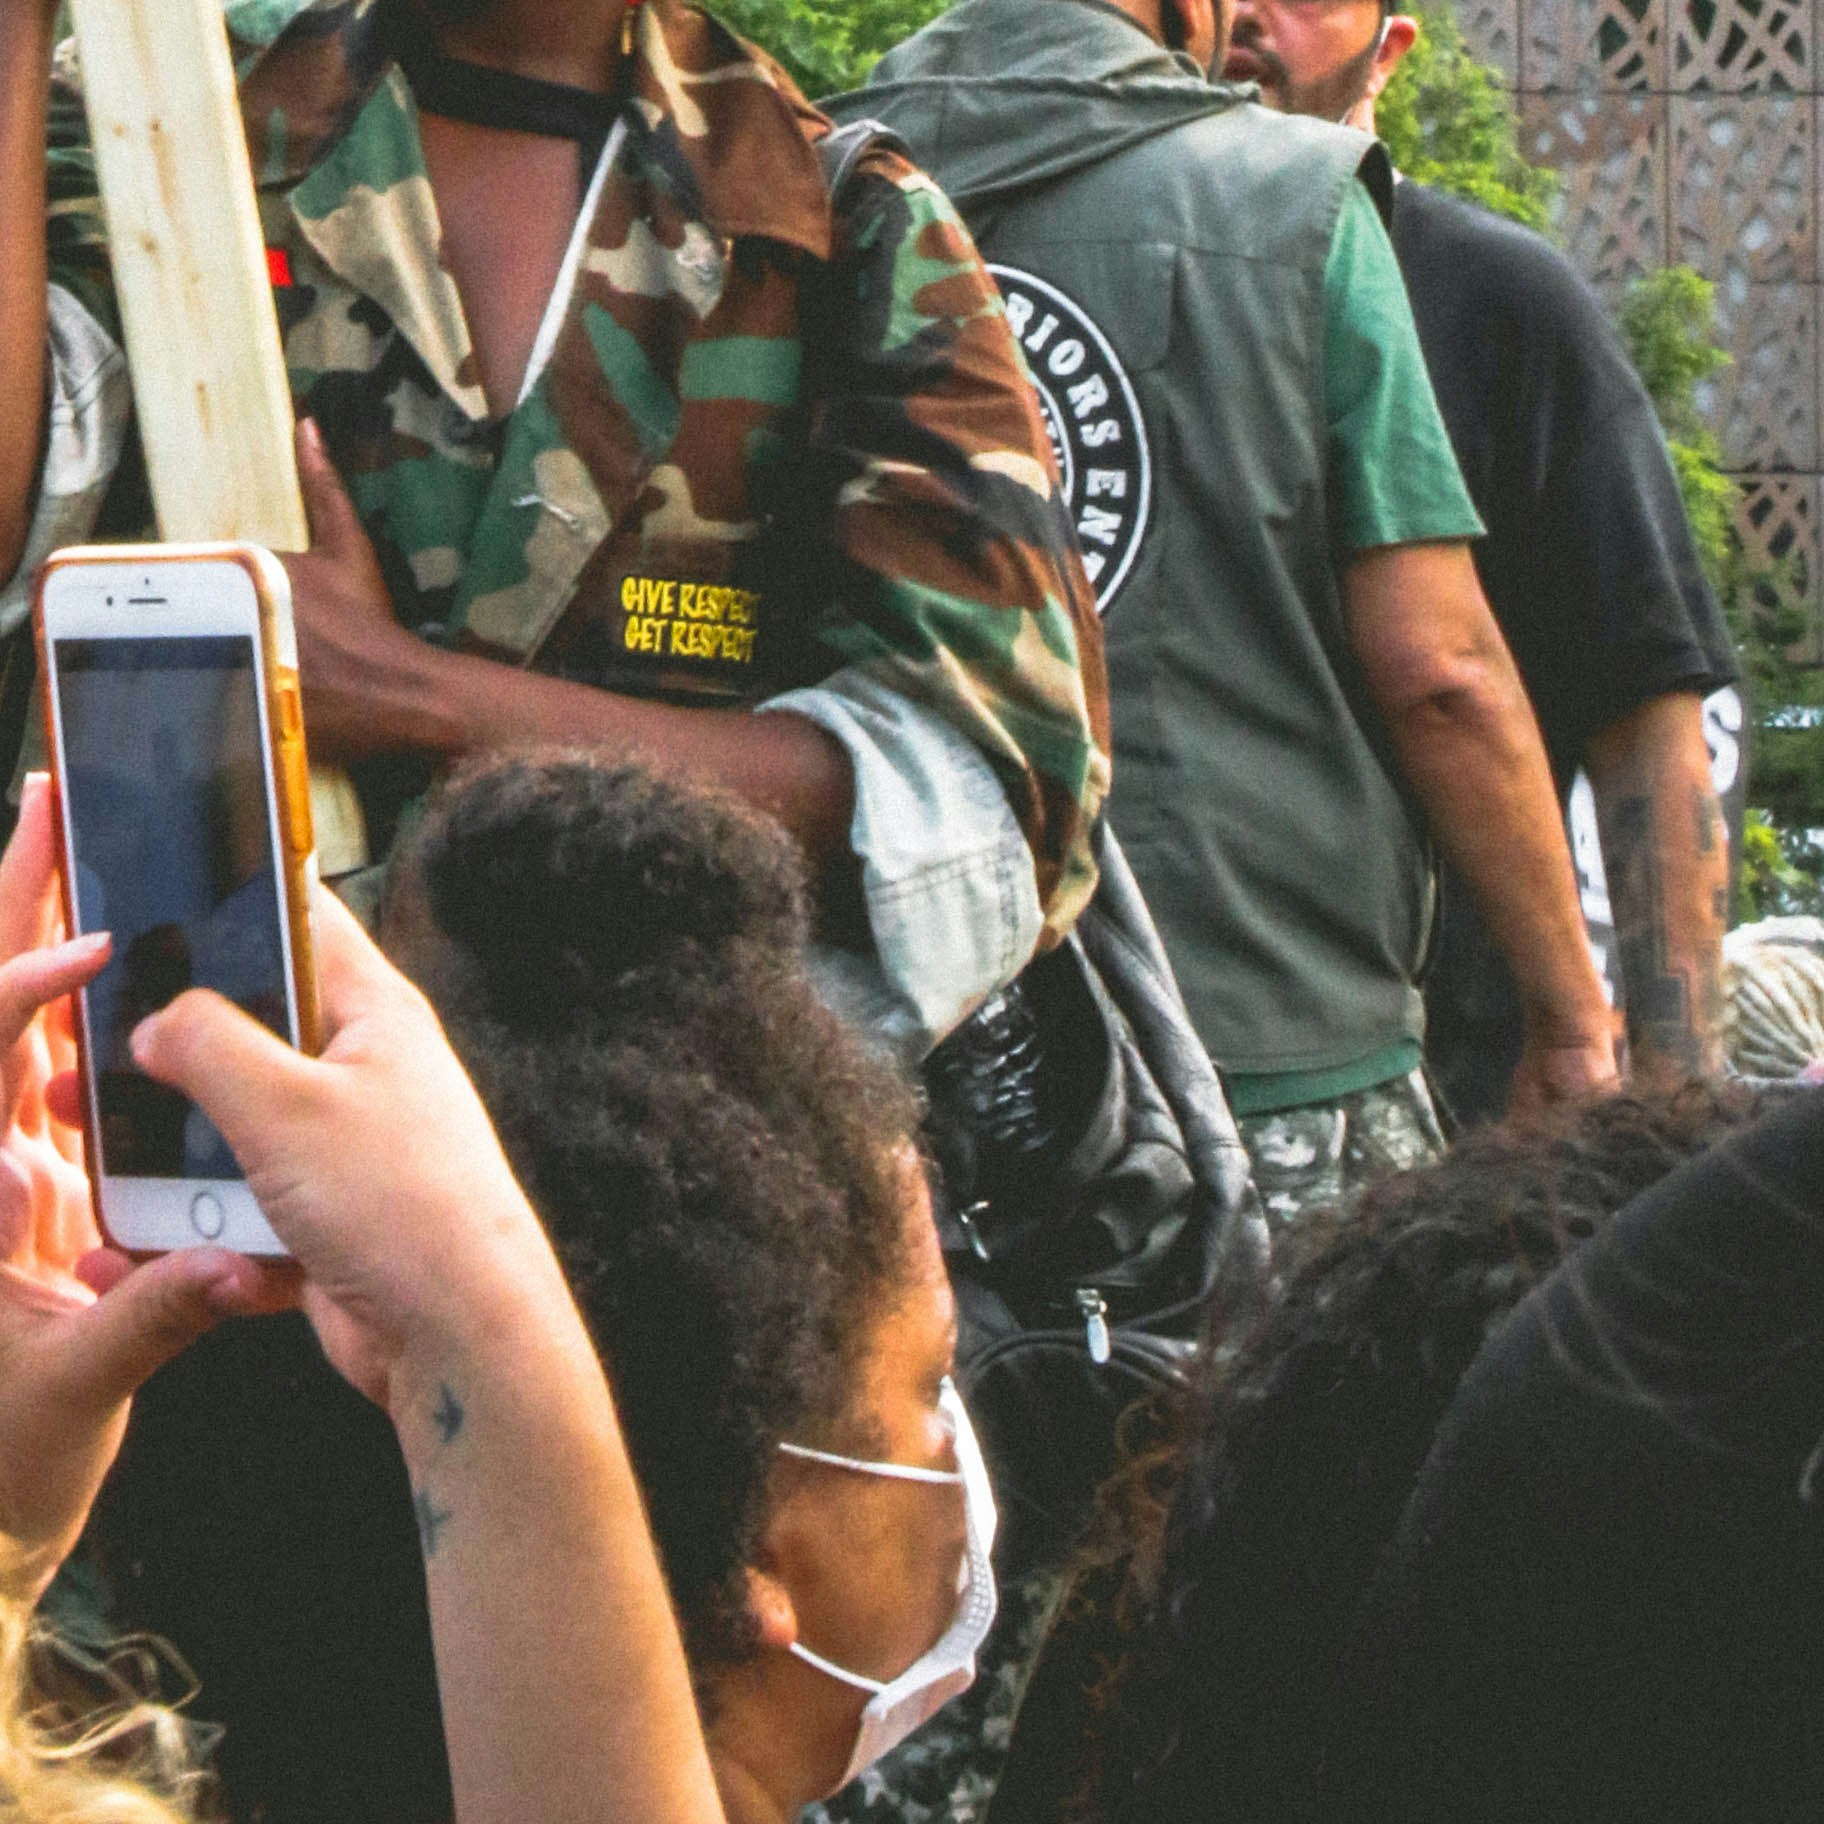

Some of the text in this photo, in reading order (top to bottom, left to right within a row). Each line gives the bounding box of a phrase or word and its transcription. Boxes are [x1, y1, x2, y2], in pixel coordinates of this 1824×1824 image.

[621, 576, 761, 624] GIVE RESPECT
[624, 615, 757, 664] GET RESPECT
